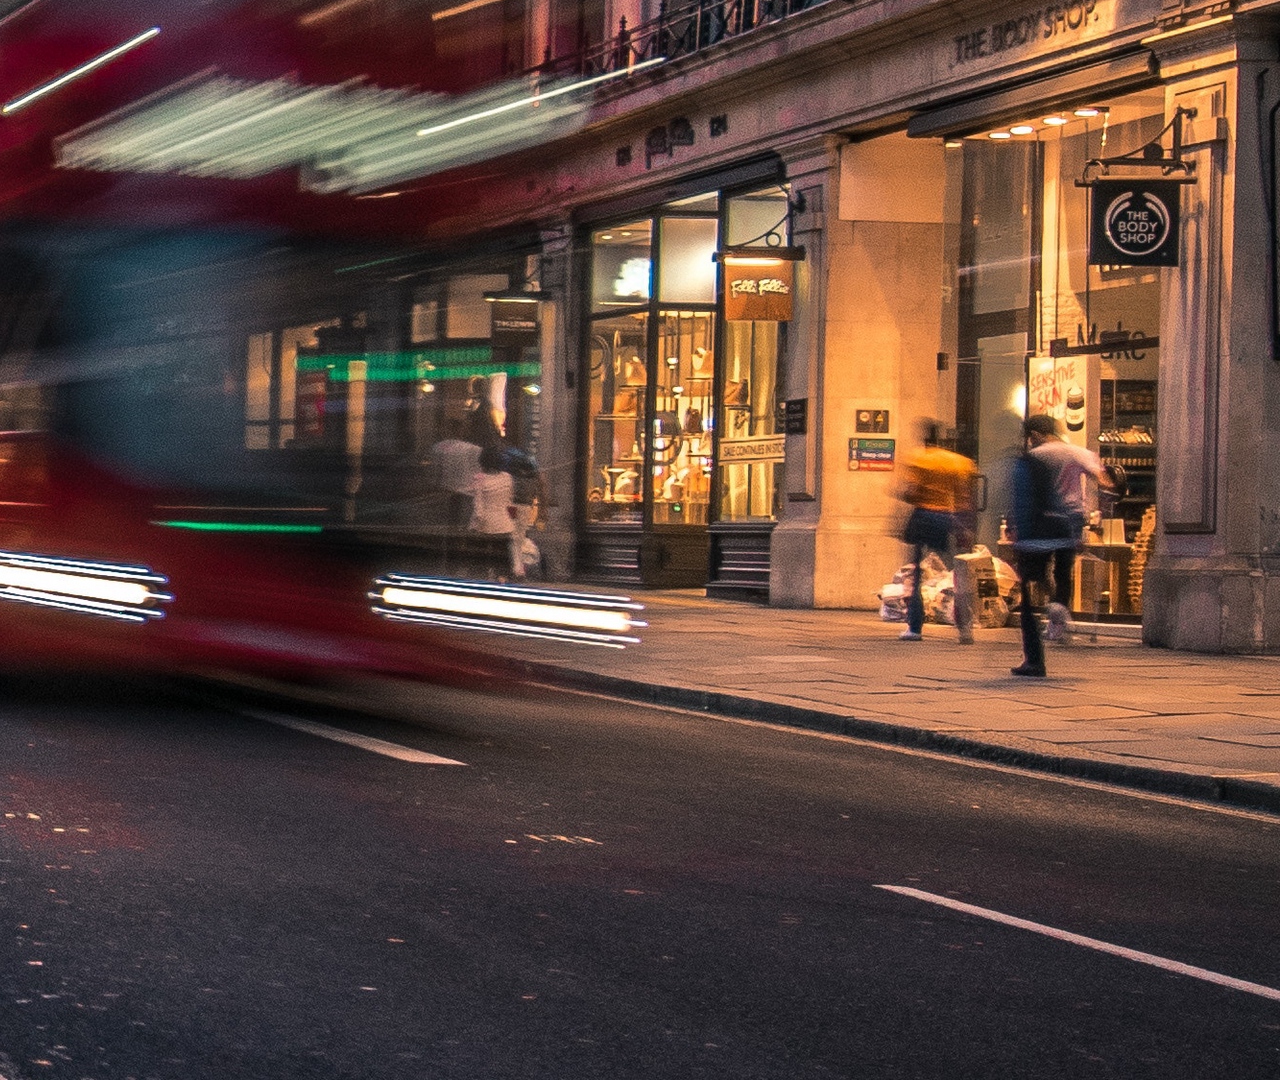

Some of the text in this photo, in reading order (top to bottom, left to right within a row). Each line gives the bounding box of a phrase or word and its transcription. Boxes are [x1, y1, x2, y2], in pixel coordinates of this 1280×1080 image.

[954, 27, 988, 64] THE
[991, 10, 1042, 54] BODY
[1118, 221, 1158, 232] BODY
[1127, 211, 1149, 221] THE
[1120, 232, 1156, 244] SHOP
[1077, 320, 1146, 361] Me
[1031, 361, 1075, 394] SENSITIVE
[1038, 387, 1062, 411] SKIN
